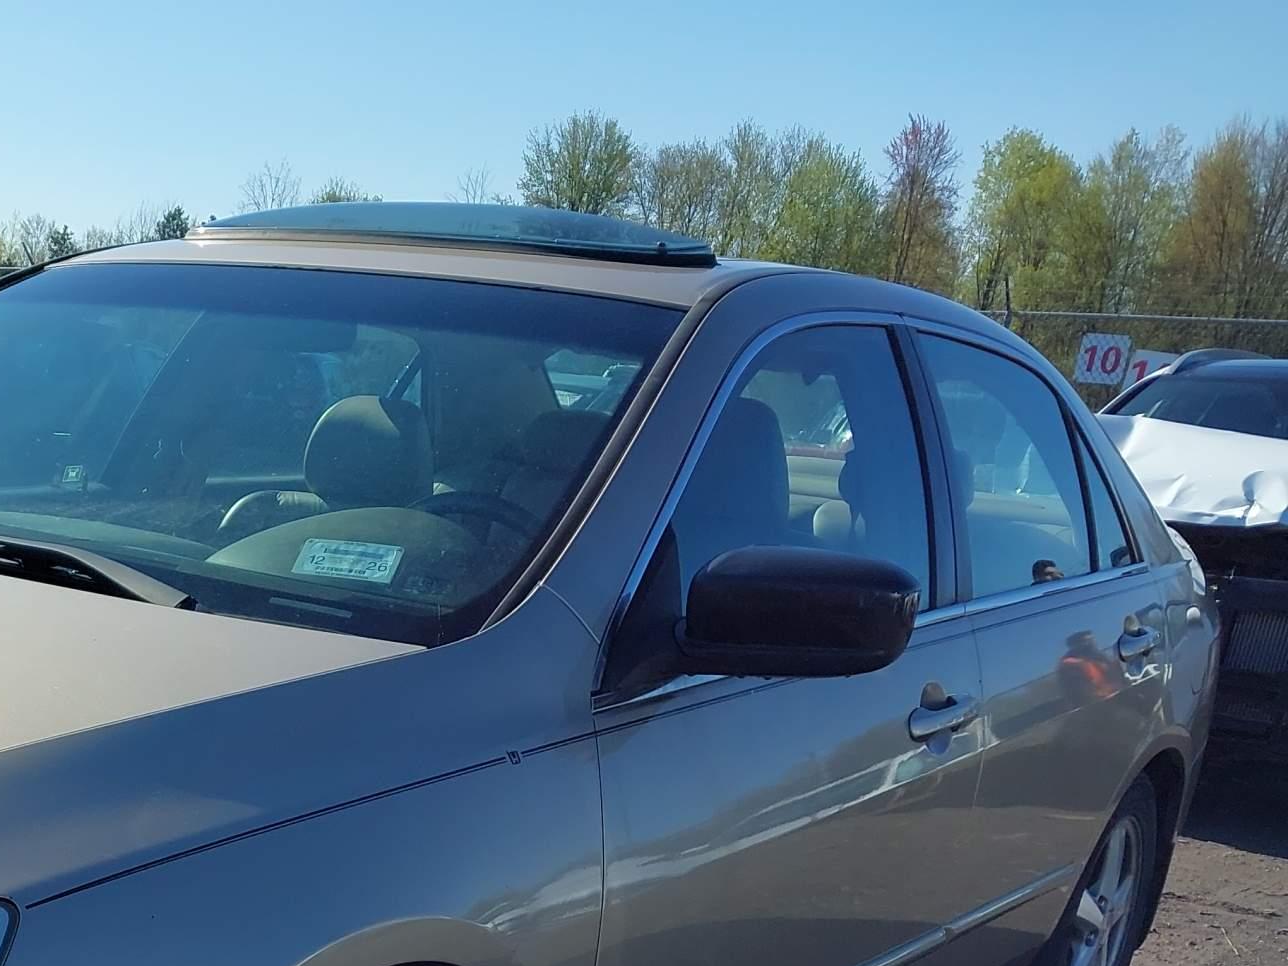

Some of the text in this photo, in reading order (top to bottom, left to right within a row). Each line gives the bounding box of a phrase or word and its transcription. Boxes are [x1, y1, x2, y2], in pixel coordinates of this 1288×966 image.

[1084, 345, 1122, 375] 10
[1132, 360, 1172, 381] 1
[309, 554, 326, 565] 12
[366, 561, 389, 572] 26
